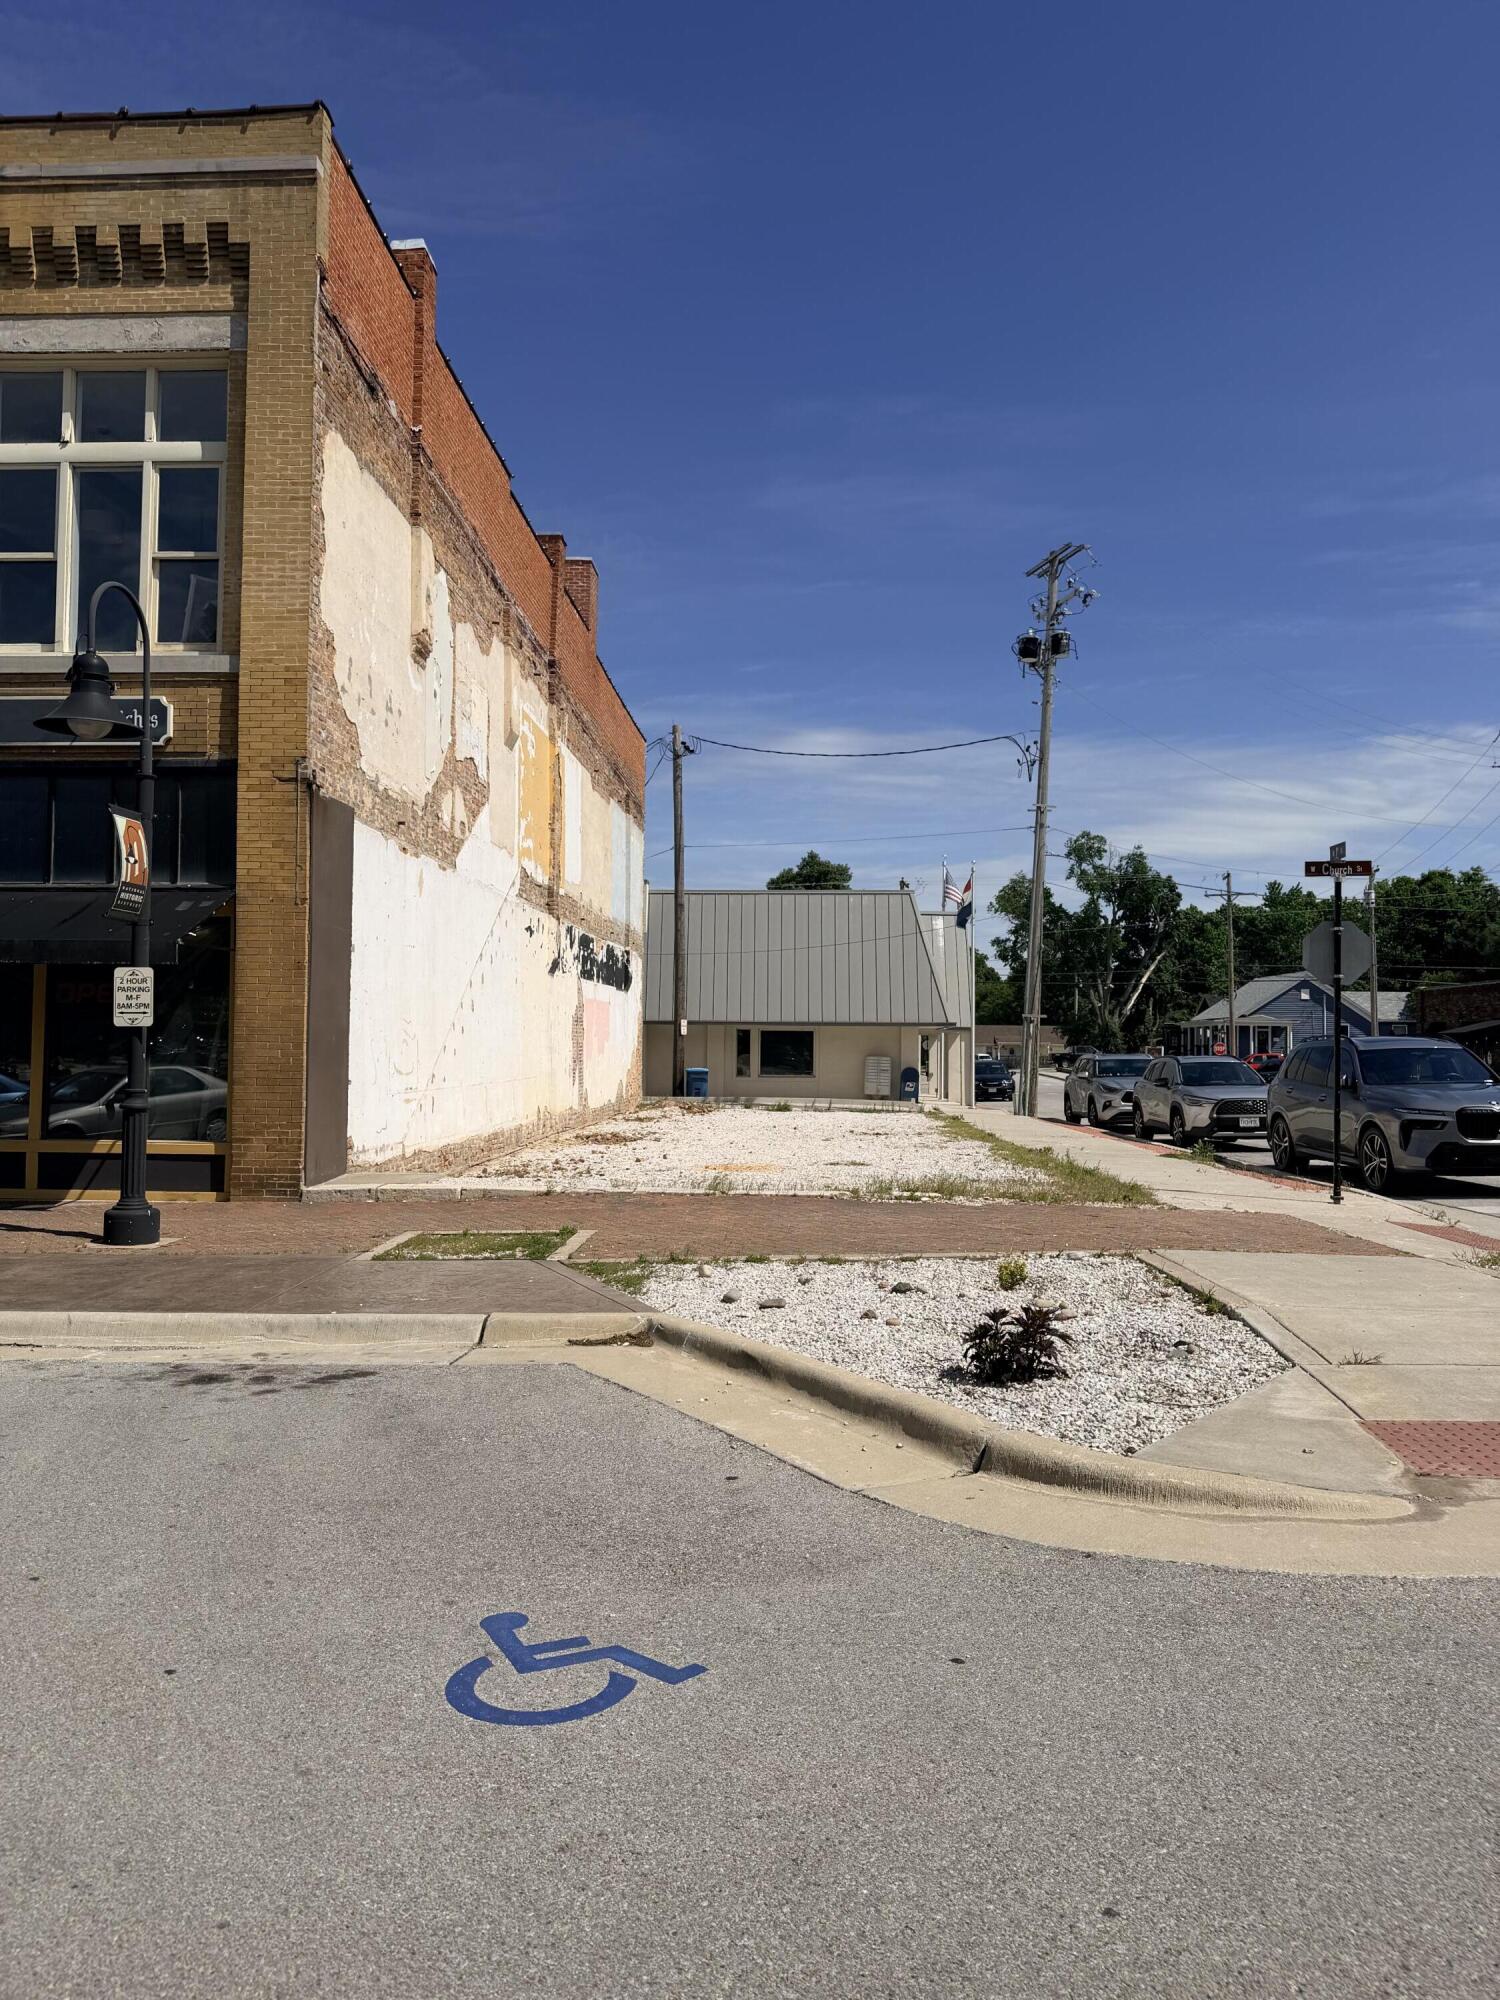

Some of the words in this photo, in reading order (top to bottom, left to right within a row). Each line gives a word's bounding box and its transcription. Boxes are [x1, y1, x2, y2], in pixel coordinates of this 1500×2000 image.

[1322, 864, 1353, 875] Church
[120, 892, 143, 902] HISTORIC
[56, 983, 114, 1004] OPE
